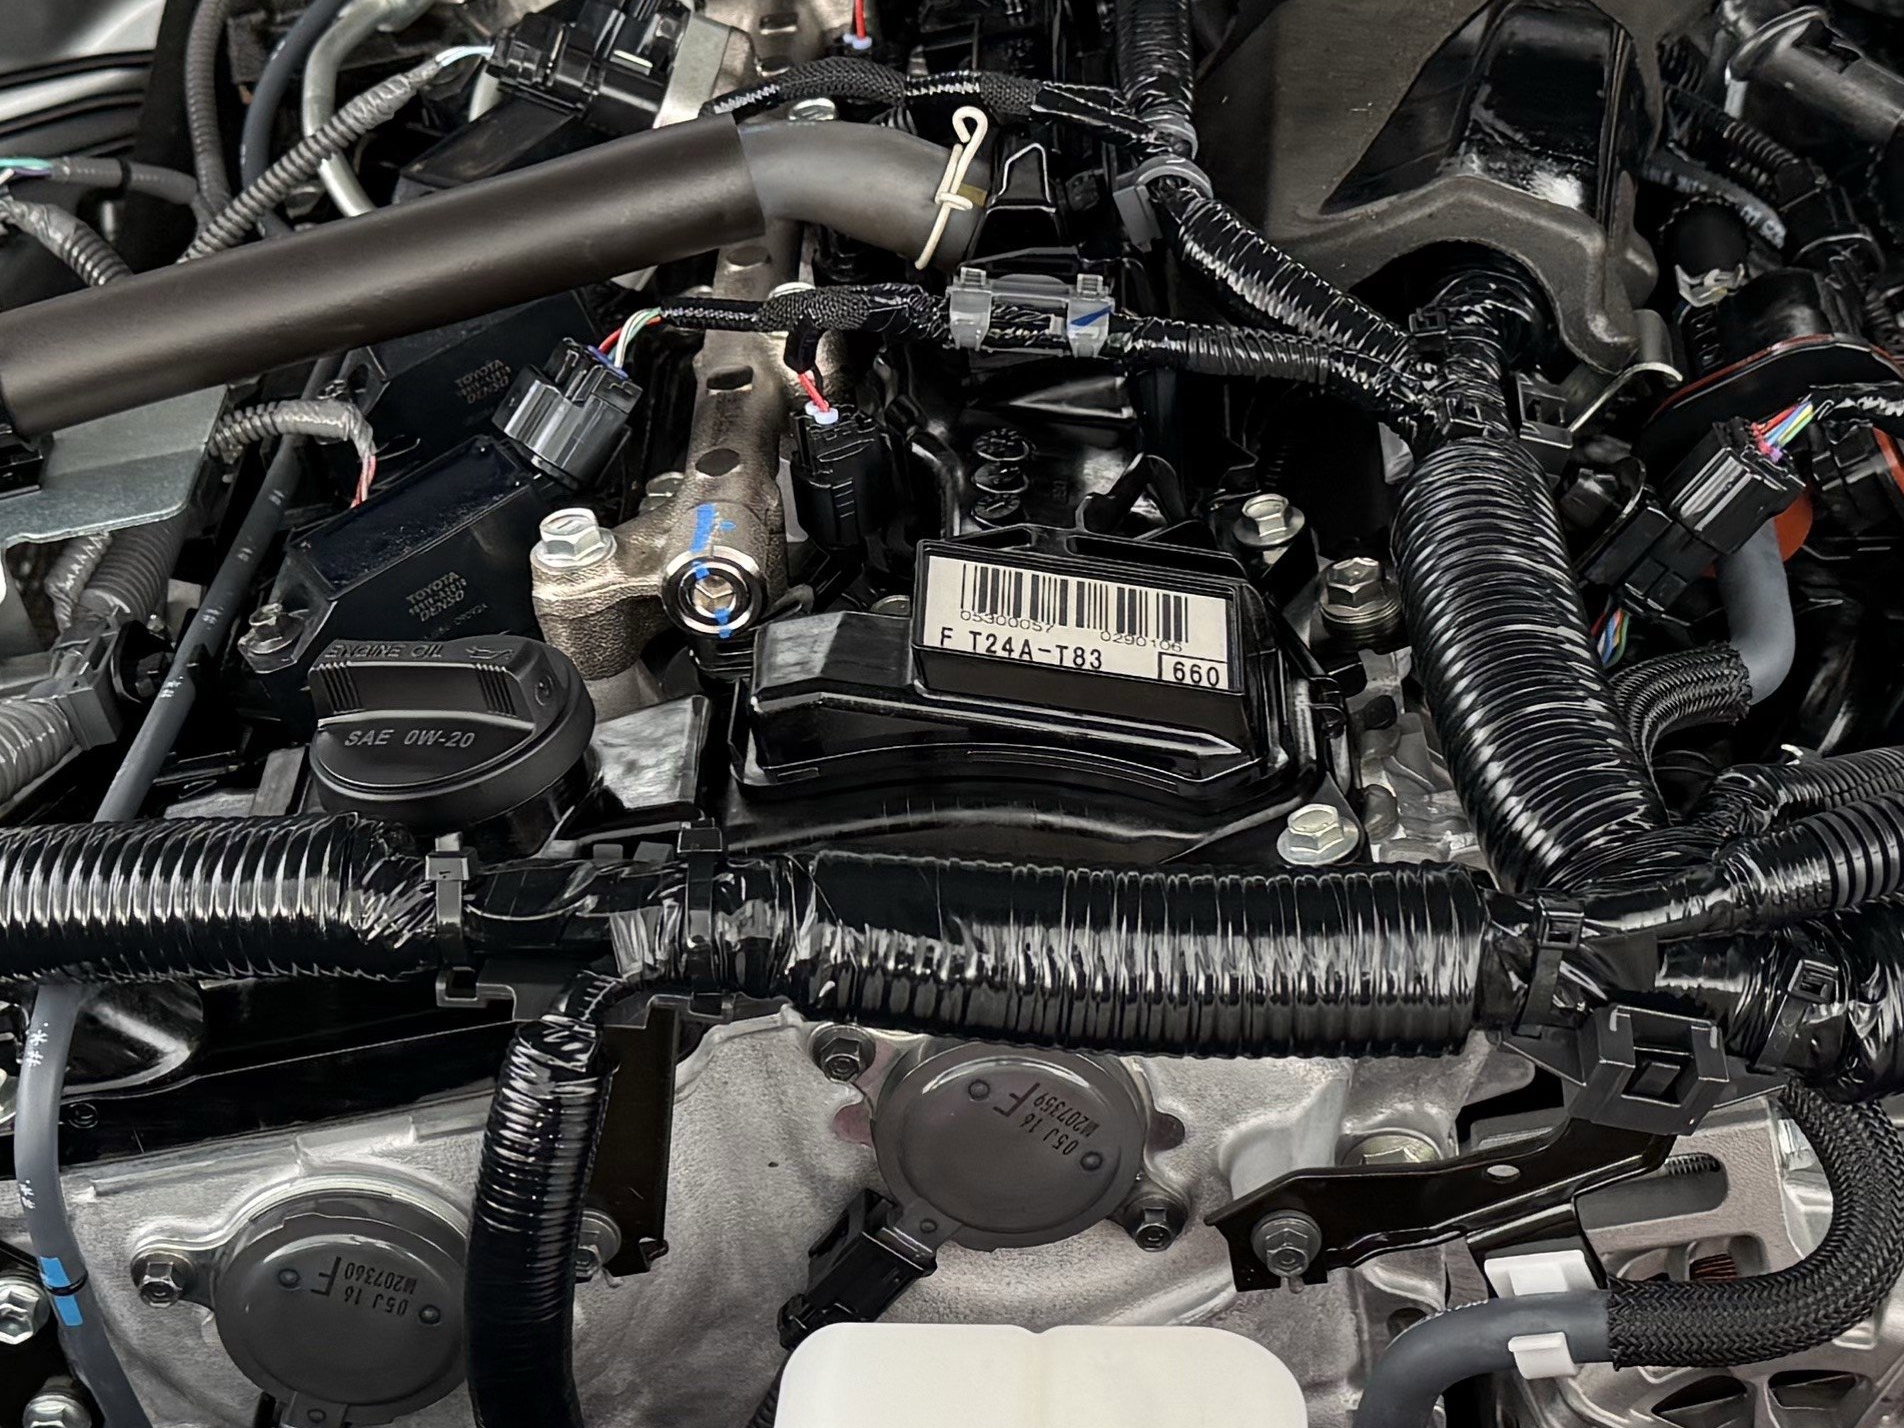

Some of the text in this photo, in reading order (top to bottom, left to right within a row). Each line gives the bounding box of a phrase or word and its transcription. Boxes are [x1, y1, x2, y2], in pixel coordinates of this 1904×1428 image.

[324, 644, 445, 659] ENGINE OIL
[940, 627, 1222, 688] F T24A-T83 660
[344, 729, 476, 749] SAE 0W-20
[310, 1256, 342, 1297] F
